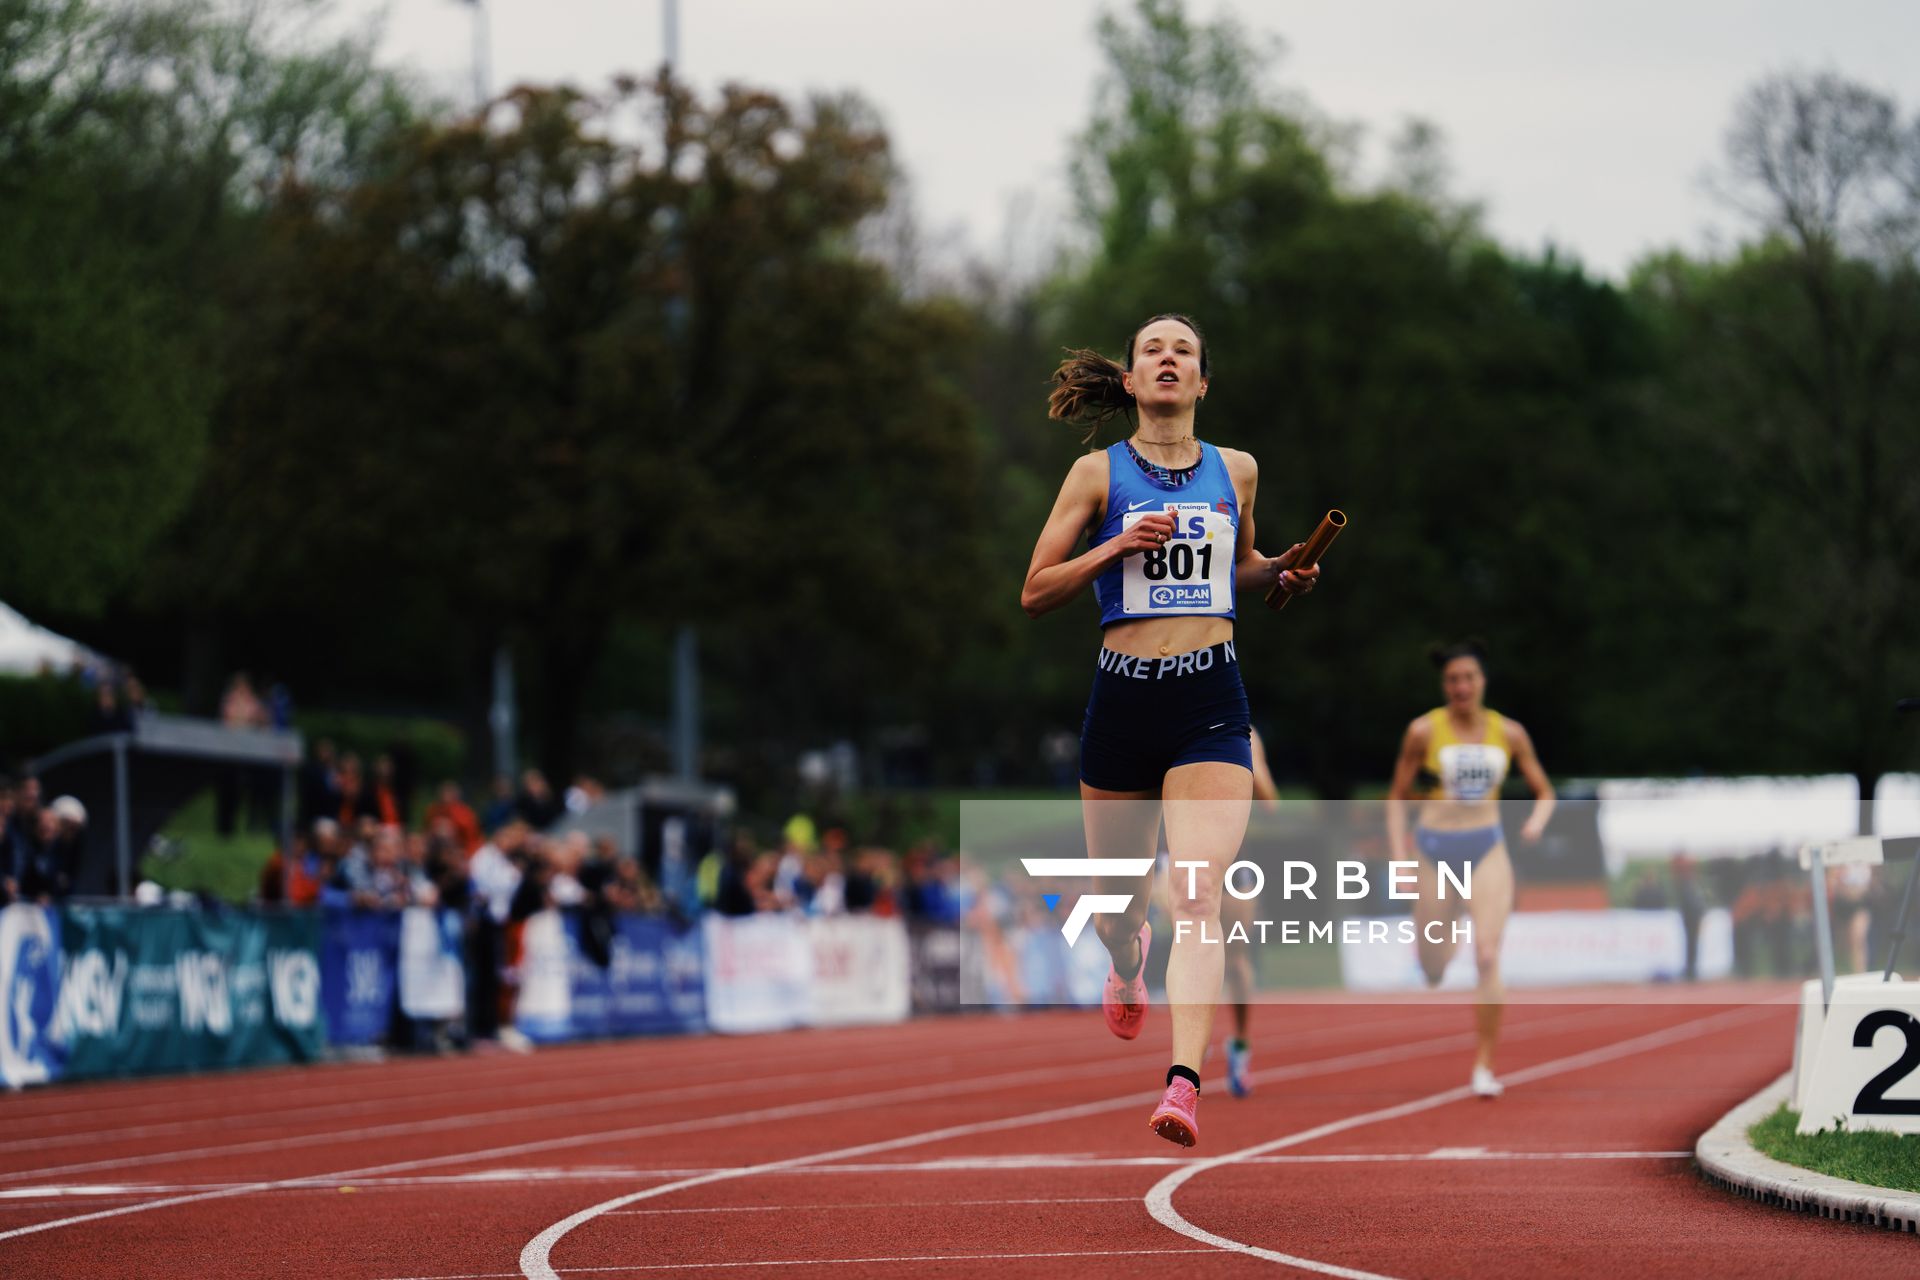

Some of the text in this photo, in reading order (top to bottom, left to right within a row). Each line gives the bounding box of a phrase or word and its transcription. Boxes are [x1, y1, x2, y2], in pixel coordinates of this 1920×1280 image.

[1143, 543, 1213, 580] 801
[1176, 588, 1209, 599] PLAN
[1097, 646, 1153, 680] NIKE
[1156, 647, 1214, 680] PRO
[1852, 1009, 1920, 1115] 2
